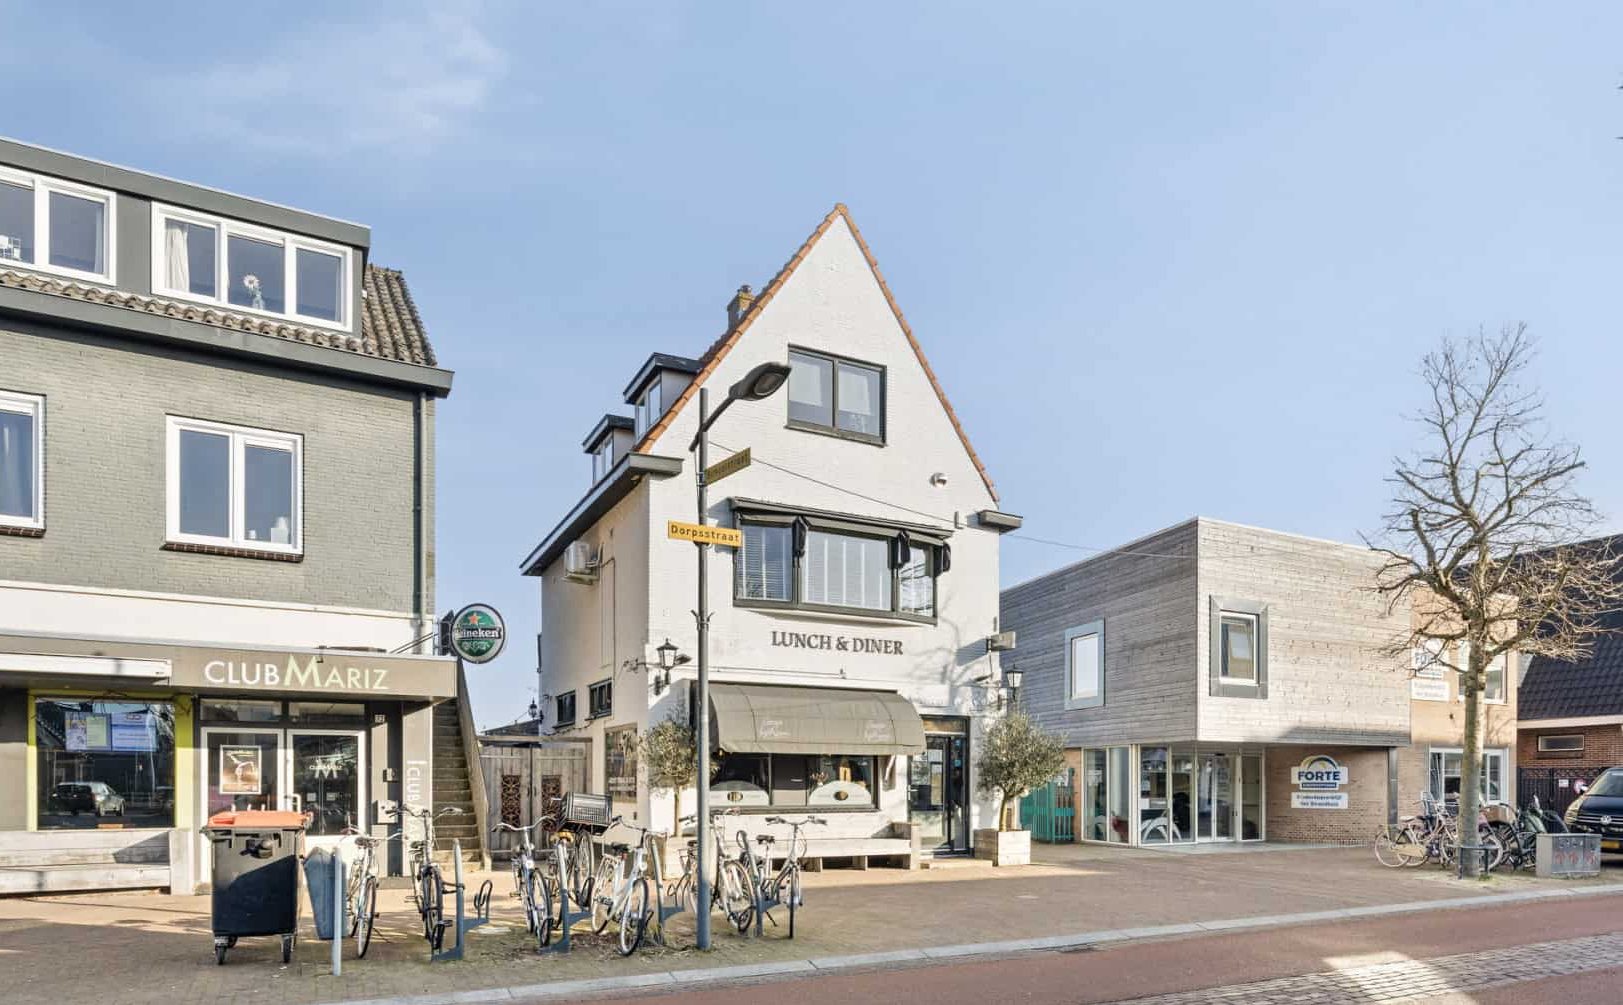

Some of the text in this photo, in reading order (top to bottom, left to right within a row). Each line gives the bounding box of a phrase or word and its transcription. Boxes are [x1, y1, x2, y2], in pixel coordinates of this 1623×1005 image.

[671, 524, 739, 542] Dorpsstraat
[455, 627, 500, 638] ineken
[771, 631, 903, 655] LUNCH & DINER
[204, 660, 280, 685] CLUB
[1298, 771, 1341, 781] FORTE
